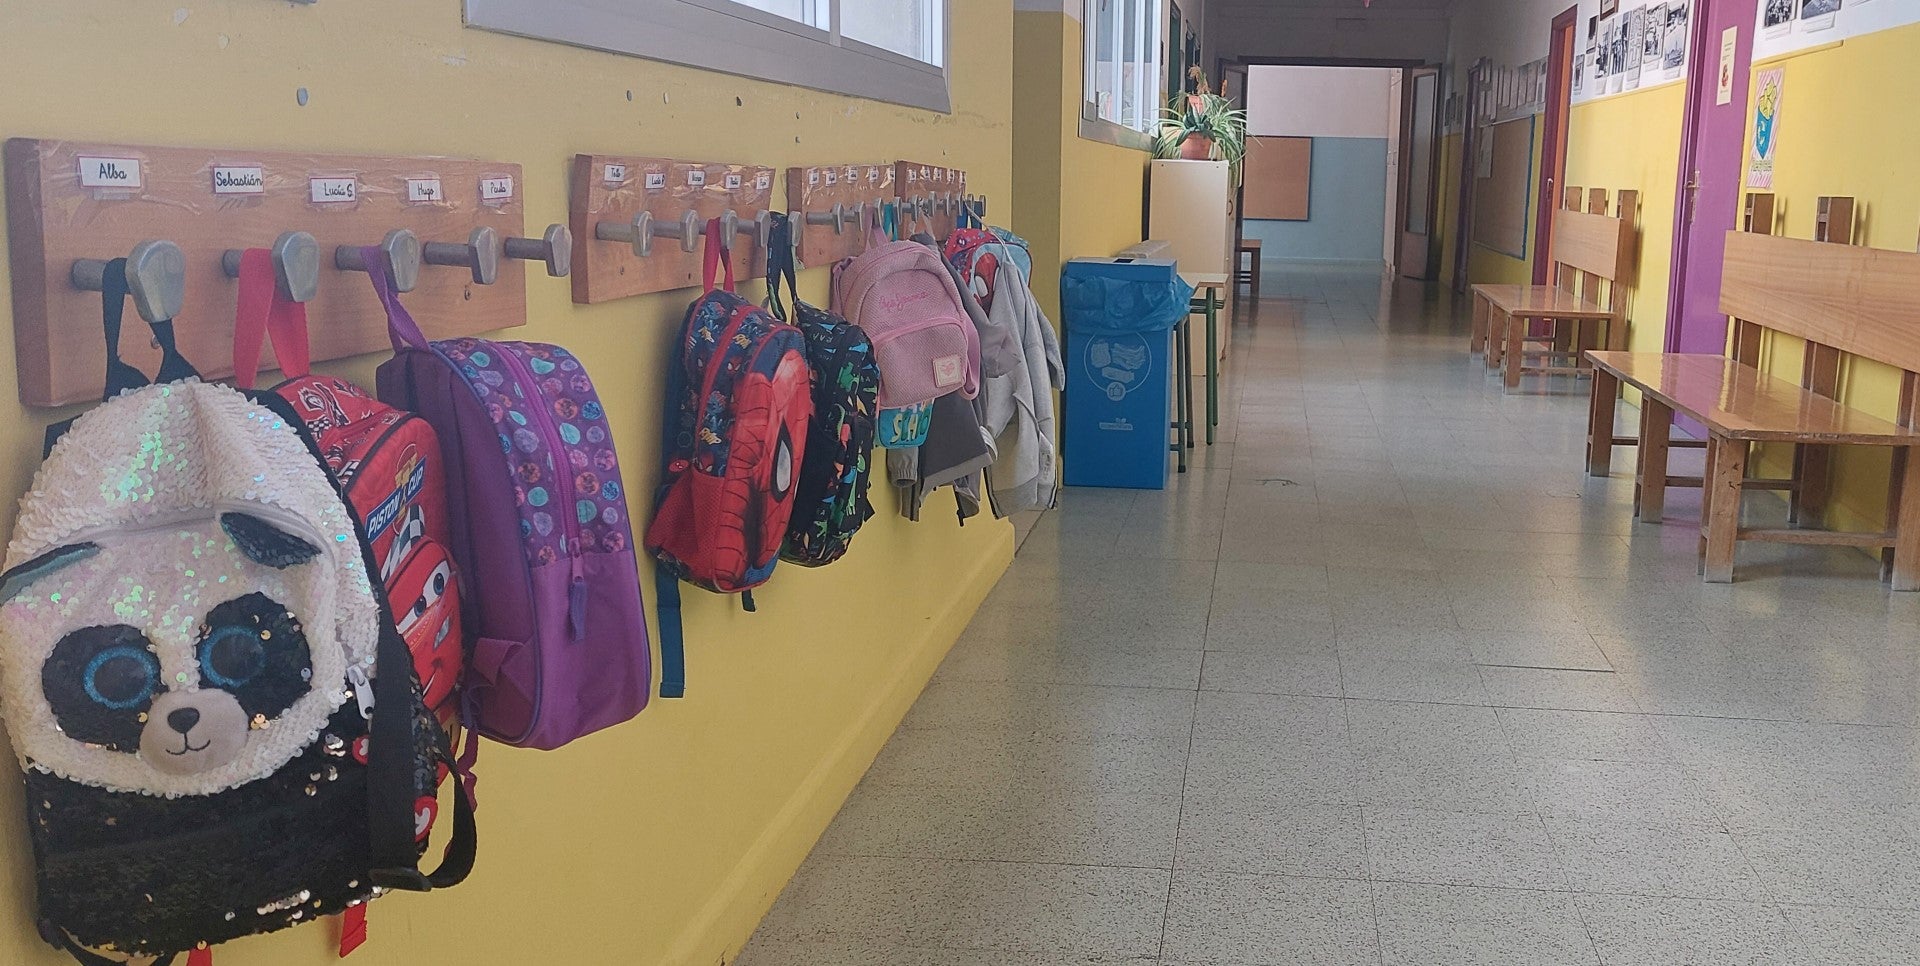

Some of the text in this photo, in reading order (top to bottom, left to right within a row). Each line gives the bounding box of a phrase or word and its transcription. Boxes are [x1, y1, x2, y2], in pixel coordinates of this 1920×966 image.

[99, 162, 127, 180] Alba
[216, 171, 263, 187] Sebastián
[323, 182, 345, 196] Lucía
[417, 182, 434, 200] Hugo
[367, 466, 424, 539] PISTON CUP
